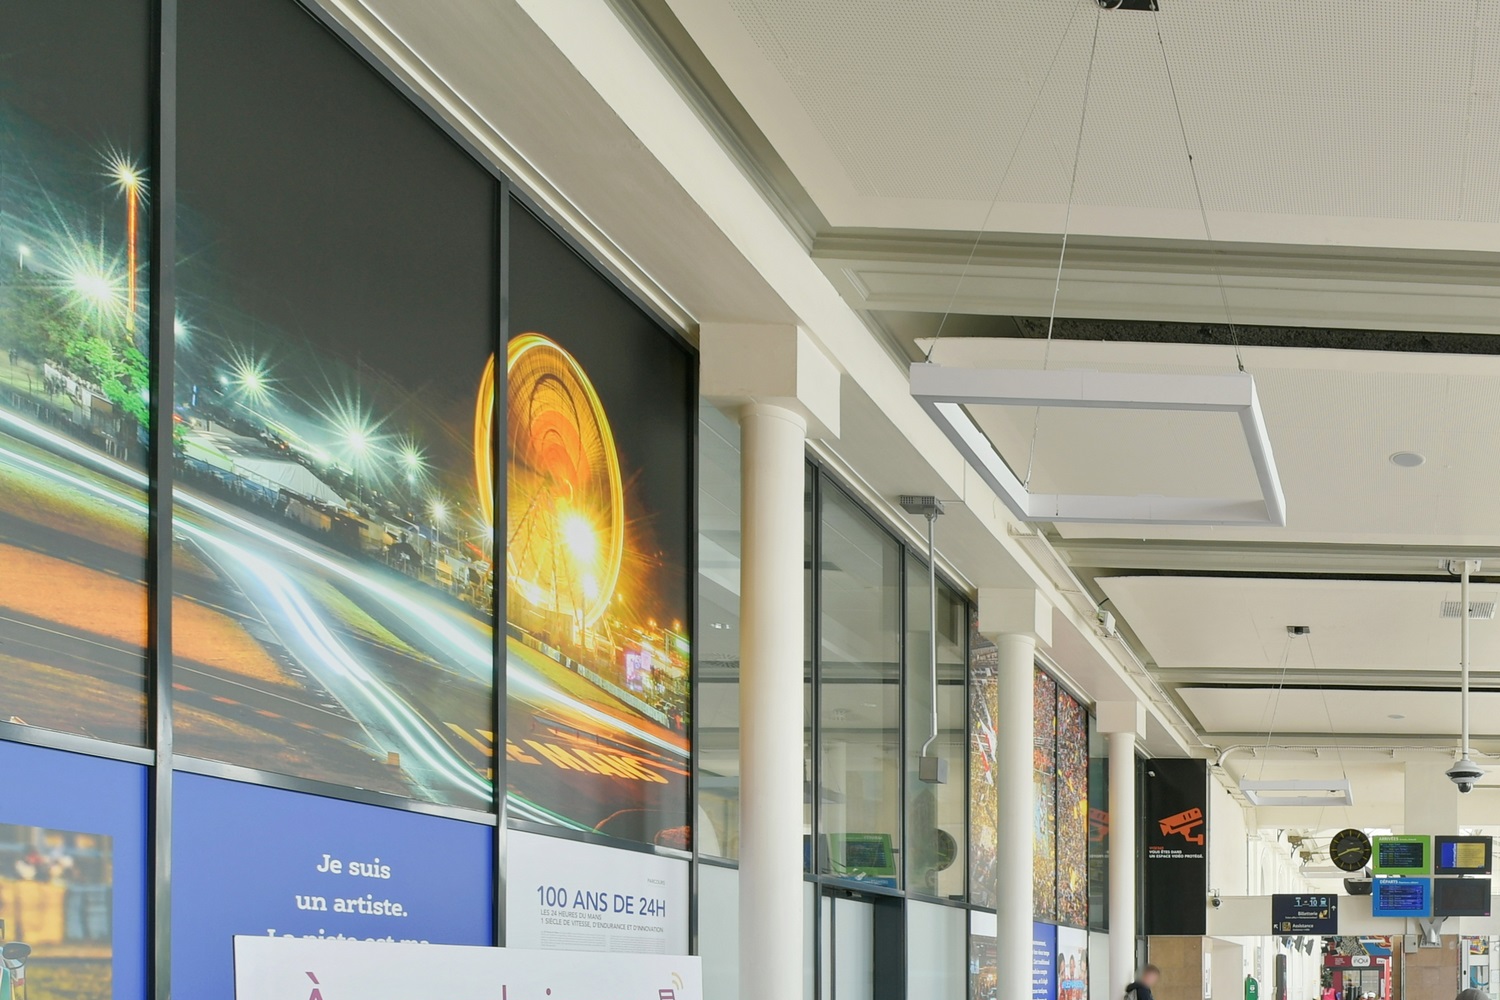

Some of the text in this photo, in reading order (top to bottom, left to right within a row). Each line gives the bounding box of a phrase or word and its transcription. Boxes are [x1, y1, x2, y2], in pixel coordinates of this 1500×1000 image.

[316, 854, 391, 879] Je suis
[295, 894, 408, 917] un artiste.
[537, 885, 665, 917] 100 ANS DE 24H
[545, 917, 562, 925] SIÈCLE
[571, 920, 591, 928] VITESSE,
[592, 921, 626, 930] D'ENDURANCE
